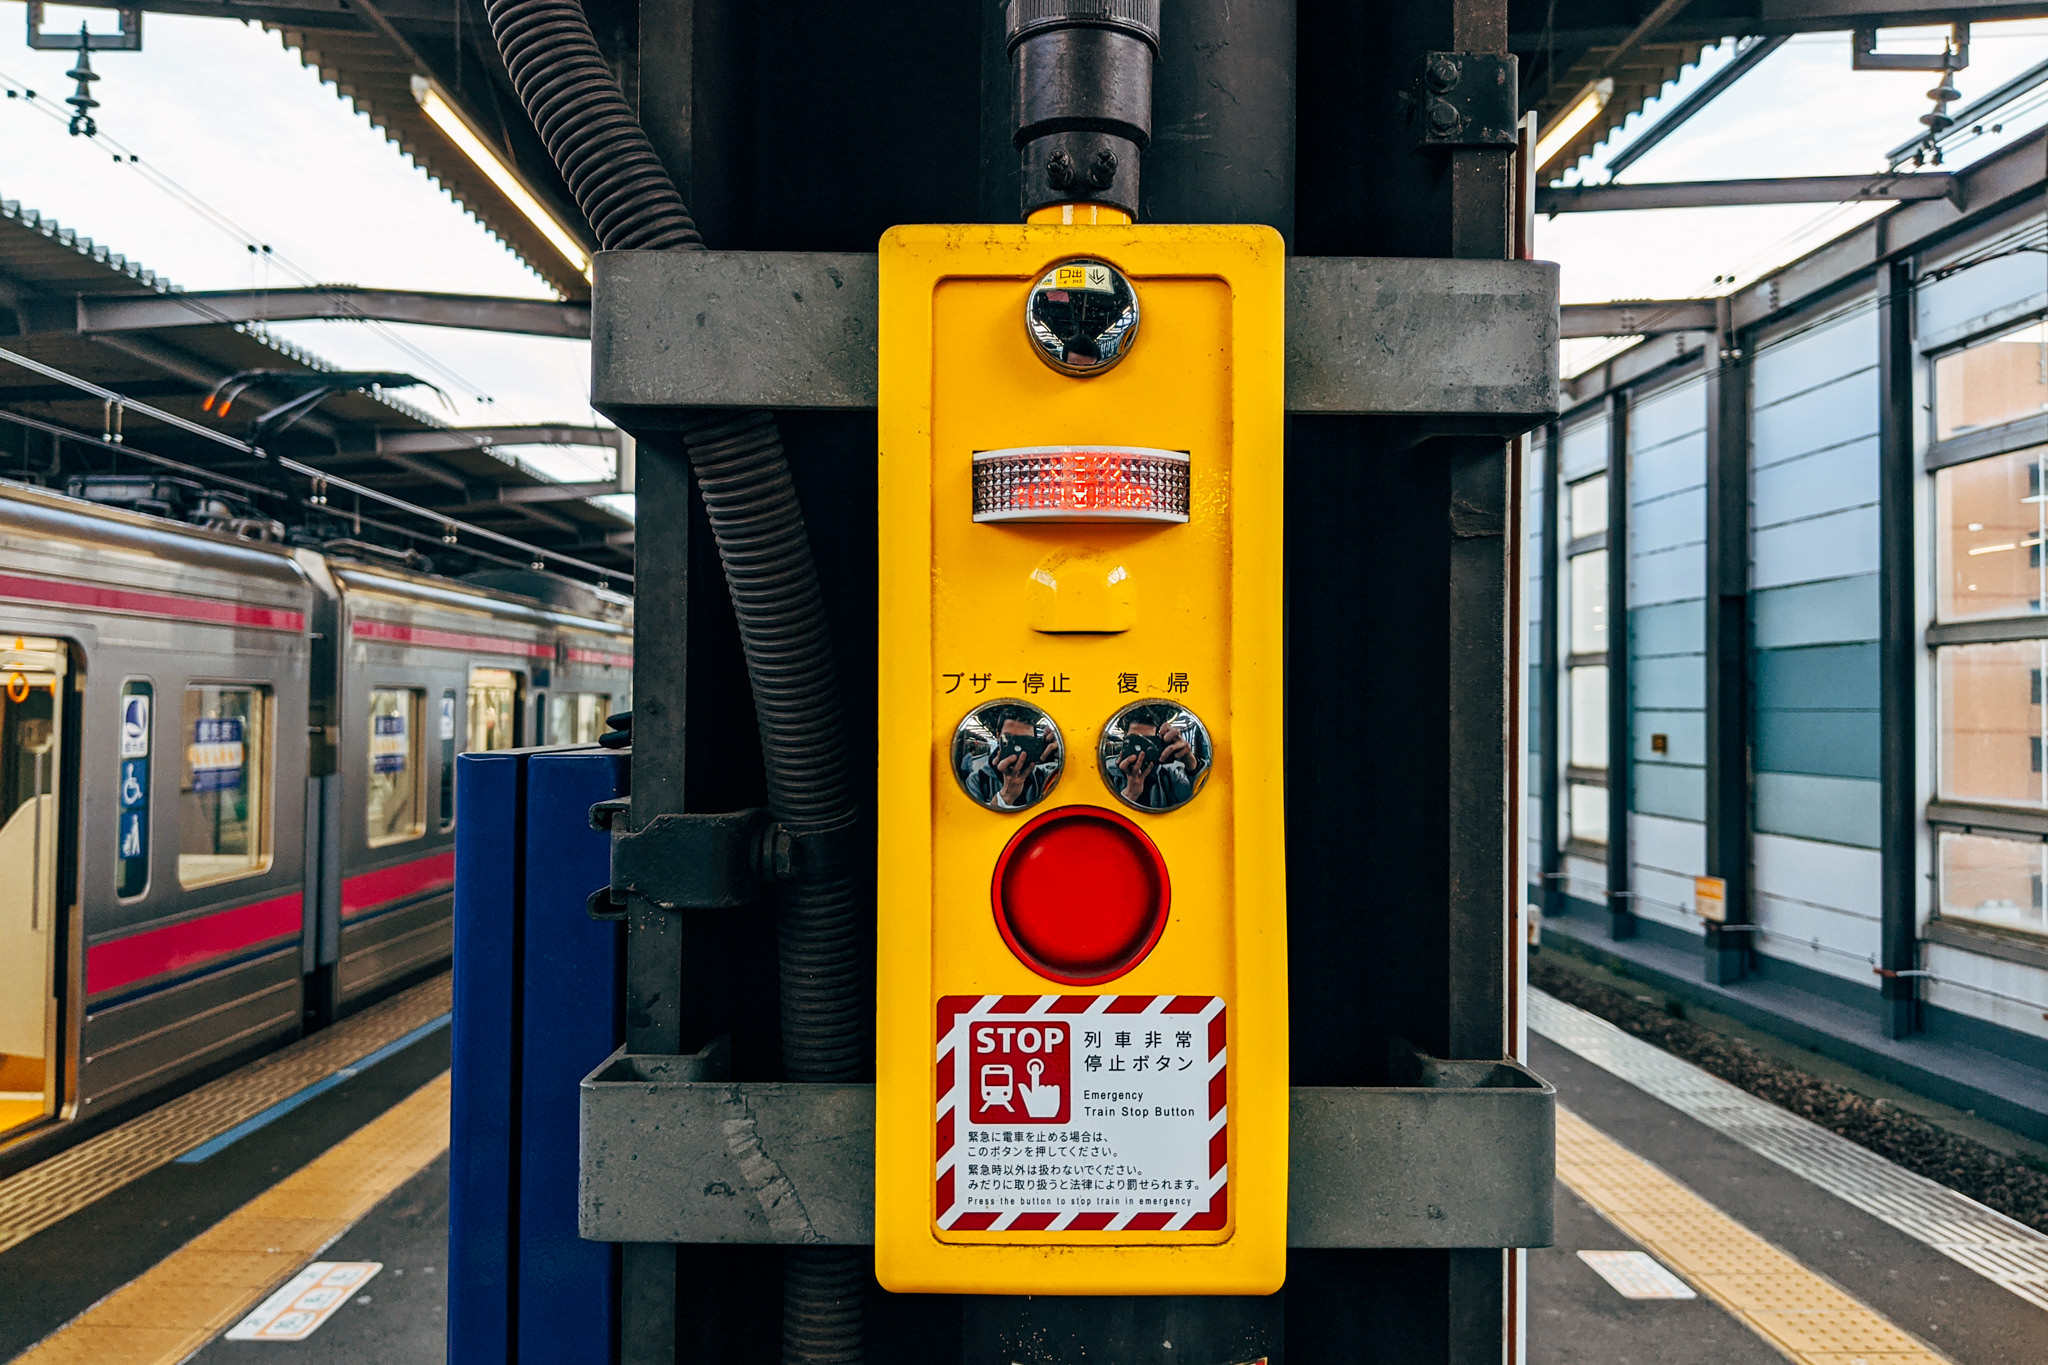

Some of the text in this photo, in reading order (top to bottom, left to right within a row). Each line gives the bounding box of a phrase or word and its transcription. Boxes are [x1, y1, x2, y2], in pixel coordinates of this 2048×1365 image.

[942, 672, 1072, 694] ブザー停止
[1117, 672, 1190, 694] 復帰
[976, 1027, 1064, 1053] STOP
[1083, 1031, 1192, 1049] 列車非常
[1083, 1054, 1193, 1073] 停止ボタン
[1083, 1089, 1144, 1103] Emergency
[1084, 1106, 1195, 1119] Train Stop Button
[968, 1130, 1108, 1143] 緊急に電車を止める場合は、
[967, 1145, 1118, 1158] このボタンを押してください。
[968, 1163, 1142, 1176] 緊急時以外は扱わないでください。
[967, 1178, 1199, 1191] みだりに取り扱うと法律により罰せられます。
[967, 1196, 1191, 1207] Press the button to stop train in emergency
